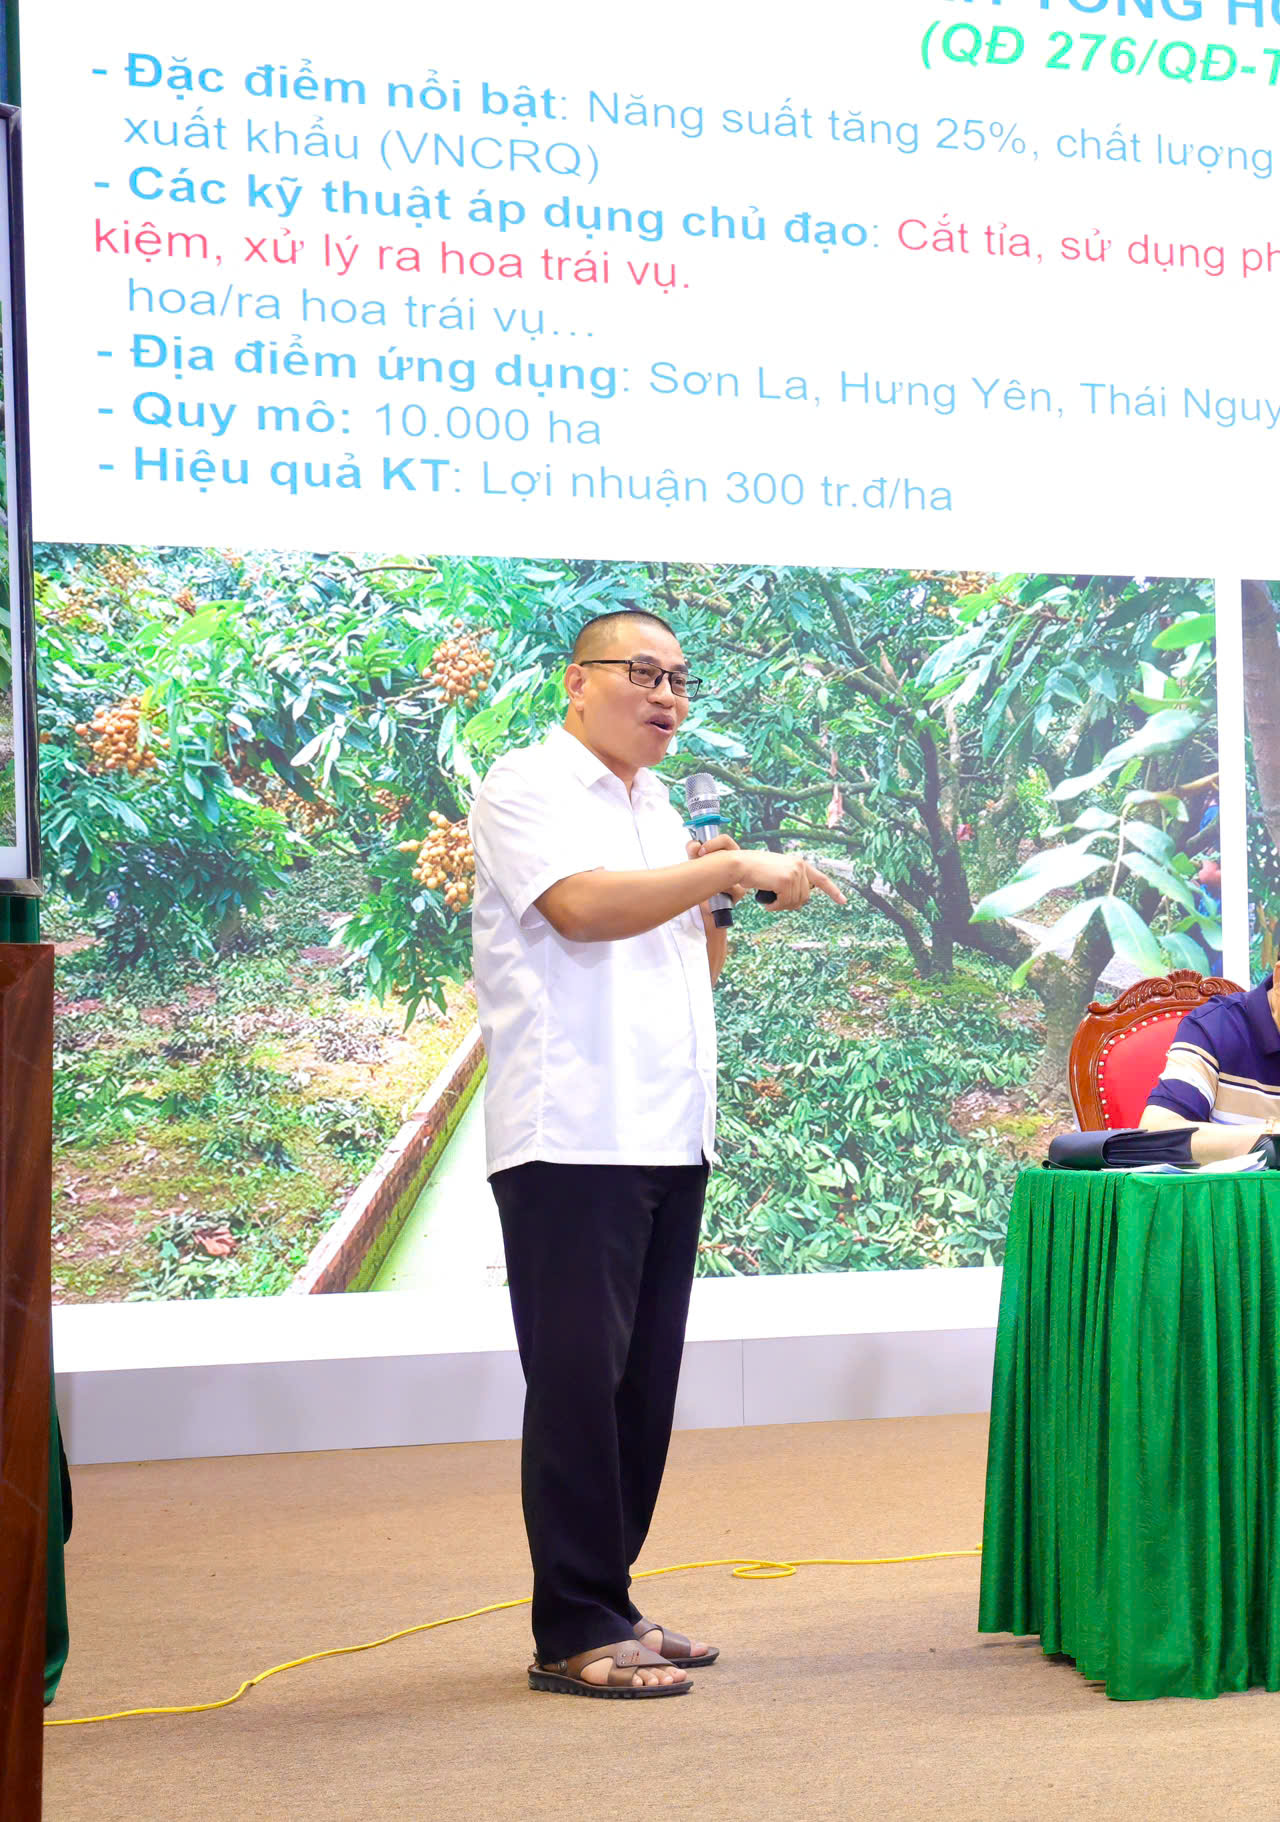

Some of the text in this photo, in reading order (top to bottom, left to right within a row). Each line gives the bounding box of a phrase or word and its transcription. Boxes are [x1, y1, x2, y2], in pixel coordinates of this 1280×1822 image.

[921, 20, 1024, 70] (QĐ
[124, 52, 224, 112] Đặc
[245, 58, 366, 104] điểm
[388, 69, 461, 112] nổi
[482, 82, 566, 127] bật:
[589, 90, 703, 138] Năng
[723, 98, 813, 139] suất
[829, 111, 918, 154] tăng
[936, 118, 1038, 159] 25%,
[1057, 124, 1141, 163] chất
[1158, 135, 1272, 179] lượng
[124, 115, 599, 184] xuất khẩu (VNCRQ)
[129, 166, 227, 205] Các
[248, 174, 303, 218] kỹ
[322, 181, 451, 228] thuật
[468, 189, 526, 232] áp
[544, 196, 663, 242] dụng
[683, 205, 766, 240] chủ
[784, 212, 878, 254] đạo:
[898, 213, 968, 254] Cắt
[984, 224, 1042, 264] tỉa,
[1061, 228, 1111, 262] sử
[1128, 234, 1224, 276] dụng
[96, 218, 688, 294] kiệm, xử lý ra hoa trái vụ.
[129, 278, 280, 320] hoa/ra
[303, 288, 387, 327] hoa
[405, 296, 475, 331] trái
[130, 333, 214, 380] Địa
[235, 334, 356, 379] điểm
[378, 346, 475, 392] ứng
[496, 354, 629, 399] dụng:
[650, 362, 739, 397] Sơn
[760, 368, 820, 406] La,
[841, 371, 955, 415] Hưng
[972, 378, 1062, 416] Yên,
[1080, 383, 1165, 416] Thái
[133, 392, 237, 437] Quy
[258, 400, 350, 434] mô:
[376, 403, 528, 441] 10.000
[549, 410, 600, 445] ha
[136, 447, 248, 493] Hiệu
[270, 453, 361, 496] quả
[384, 457, 460, 492] KT:
[484, 461, 551, 502] Lợi
[572, 466, 707, 508] nhuận
[728, 472, 804, 505] 300
[822, 476, 952, 510] tr.đ/ha
